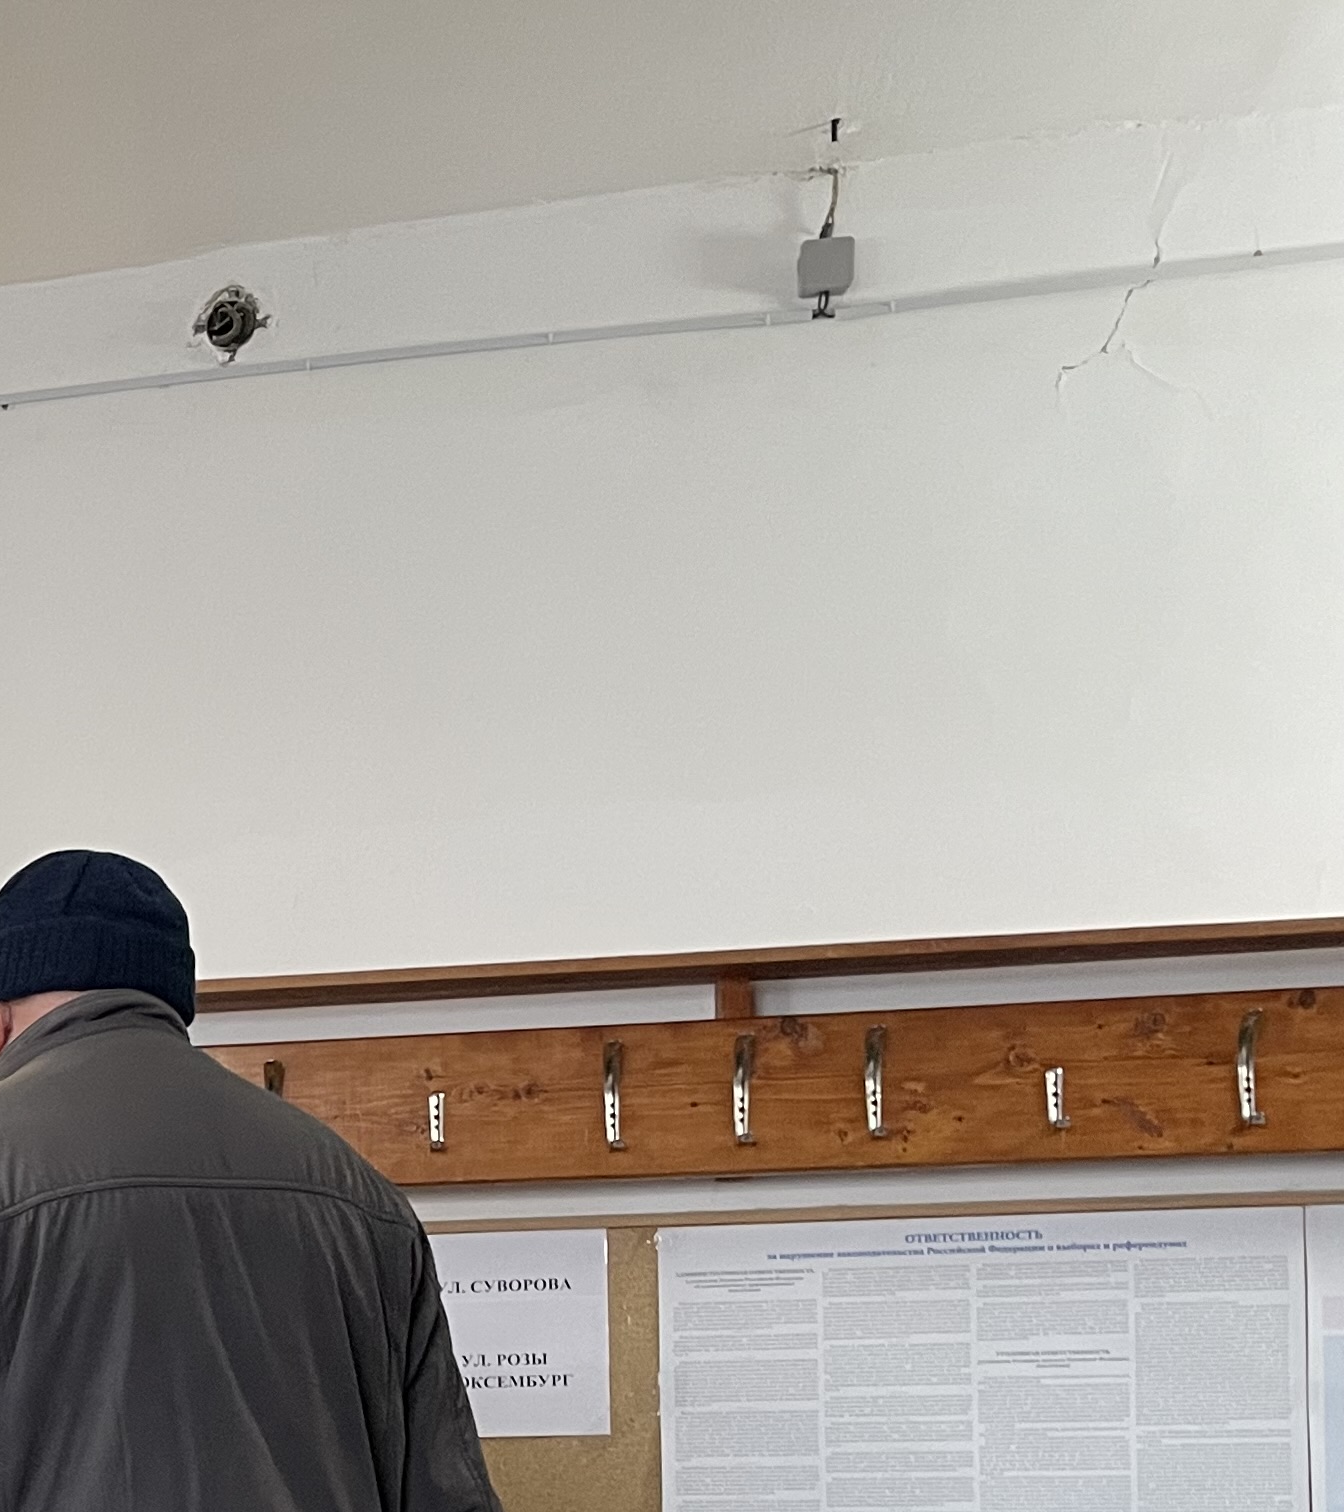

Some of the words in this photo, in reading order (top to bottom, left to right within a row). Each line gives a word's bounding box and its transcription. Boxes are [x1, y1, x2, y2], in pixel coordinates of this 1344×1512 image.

[905, 1230, 1042, 1243] ОТВЕТСТВЕННОСТЬ
[471, 1278, 572, 1293] СУВОРОВА
[462, 1355, 491, 1367] УЛ.
[497, 1353, 547, 1366] РОЗЫ
